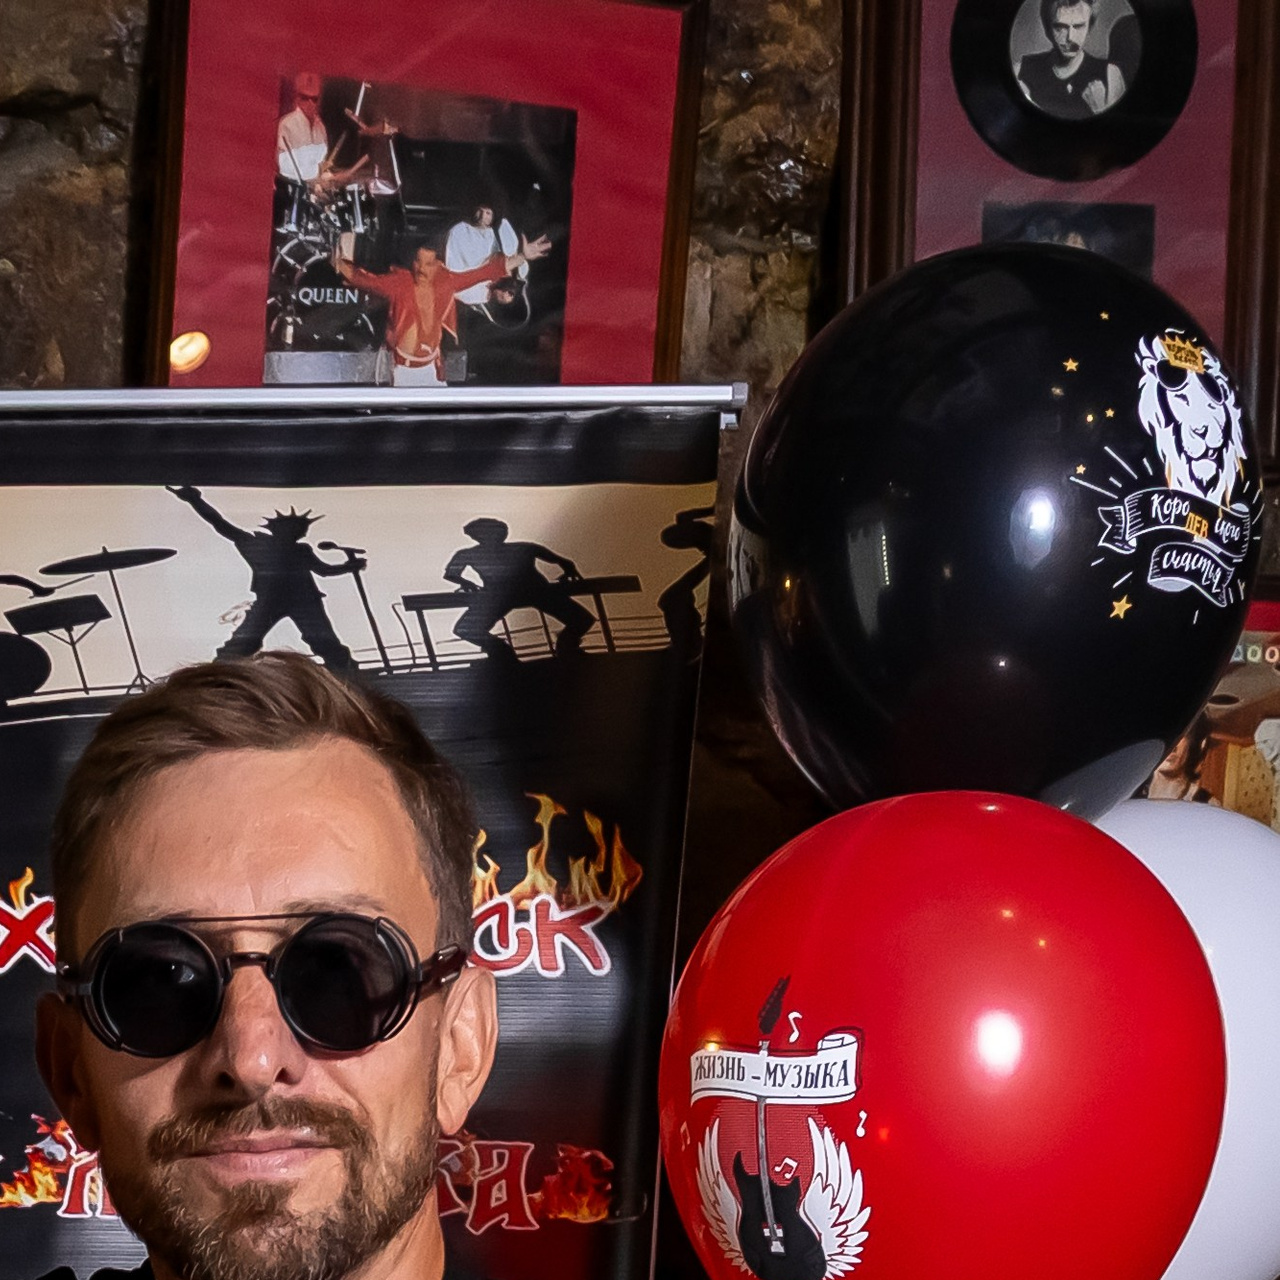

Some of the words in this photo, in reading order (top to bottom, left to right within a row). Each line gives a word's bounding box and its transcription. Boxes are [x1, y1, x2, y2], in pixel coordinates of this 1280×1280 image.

[298, 286, 359, 306] QUEEN
[694, 1055, 746, 1082] ЖИЗНЬ
[763, 1059, 850, 1089] МУЗЫКА
